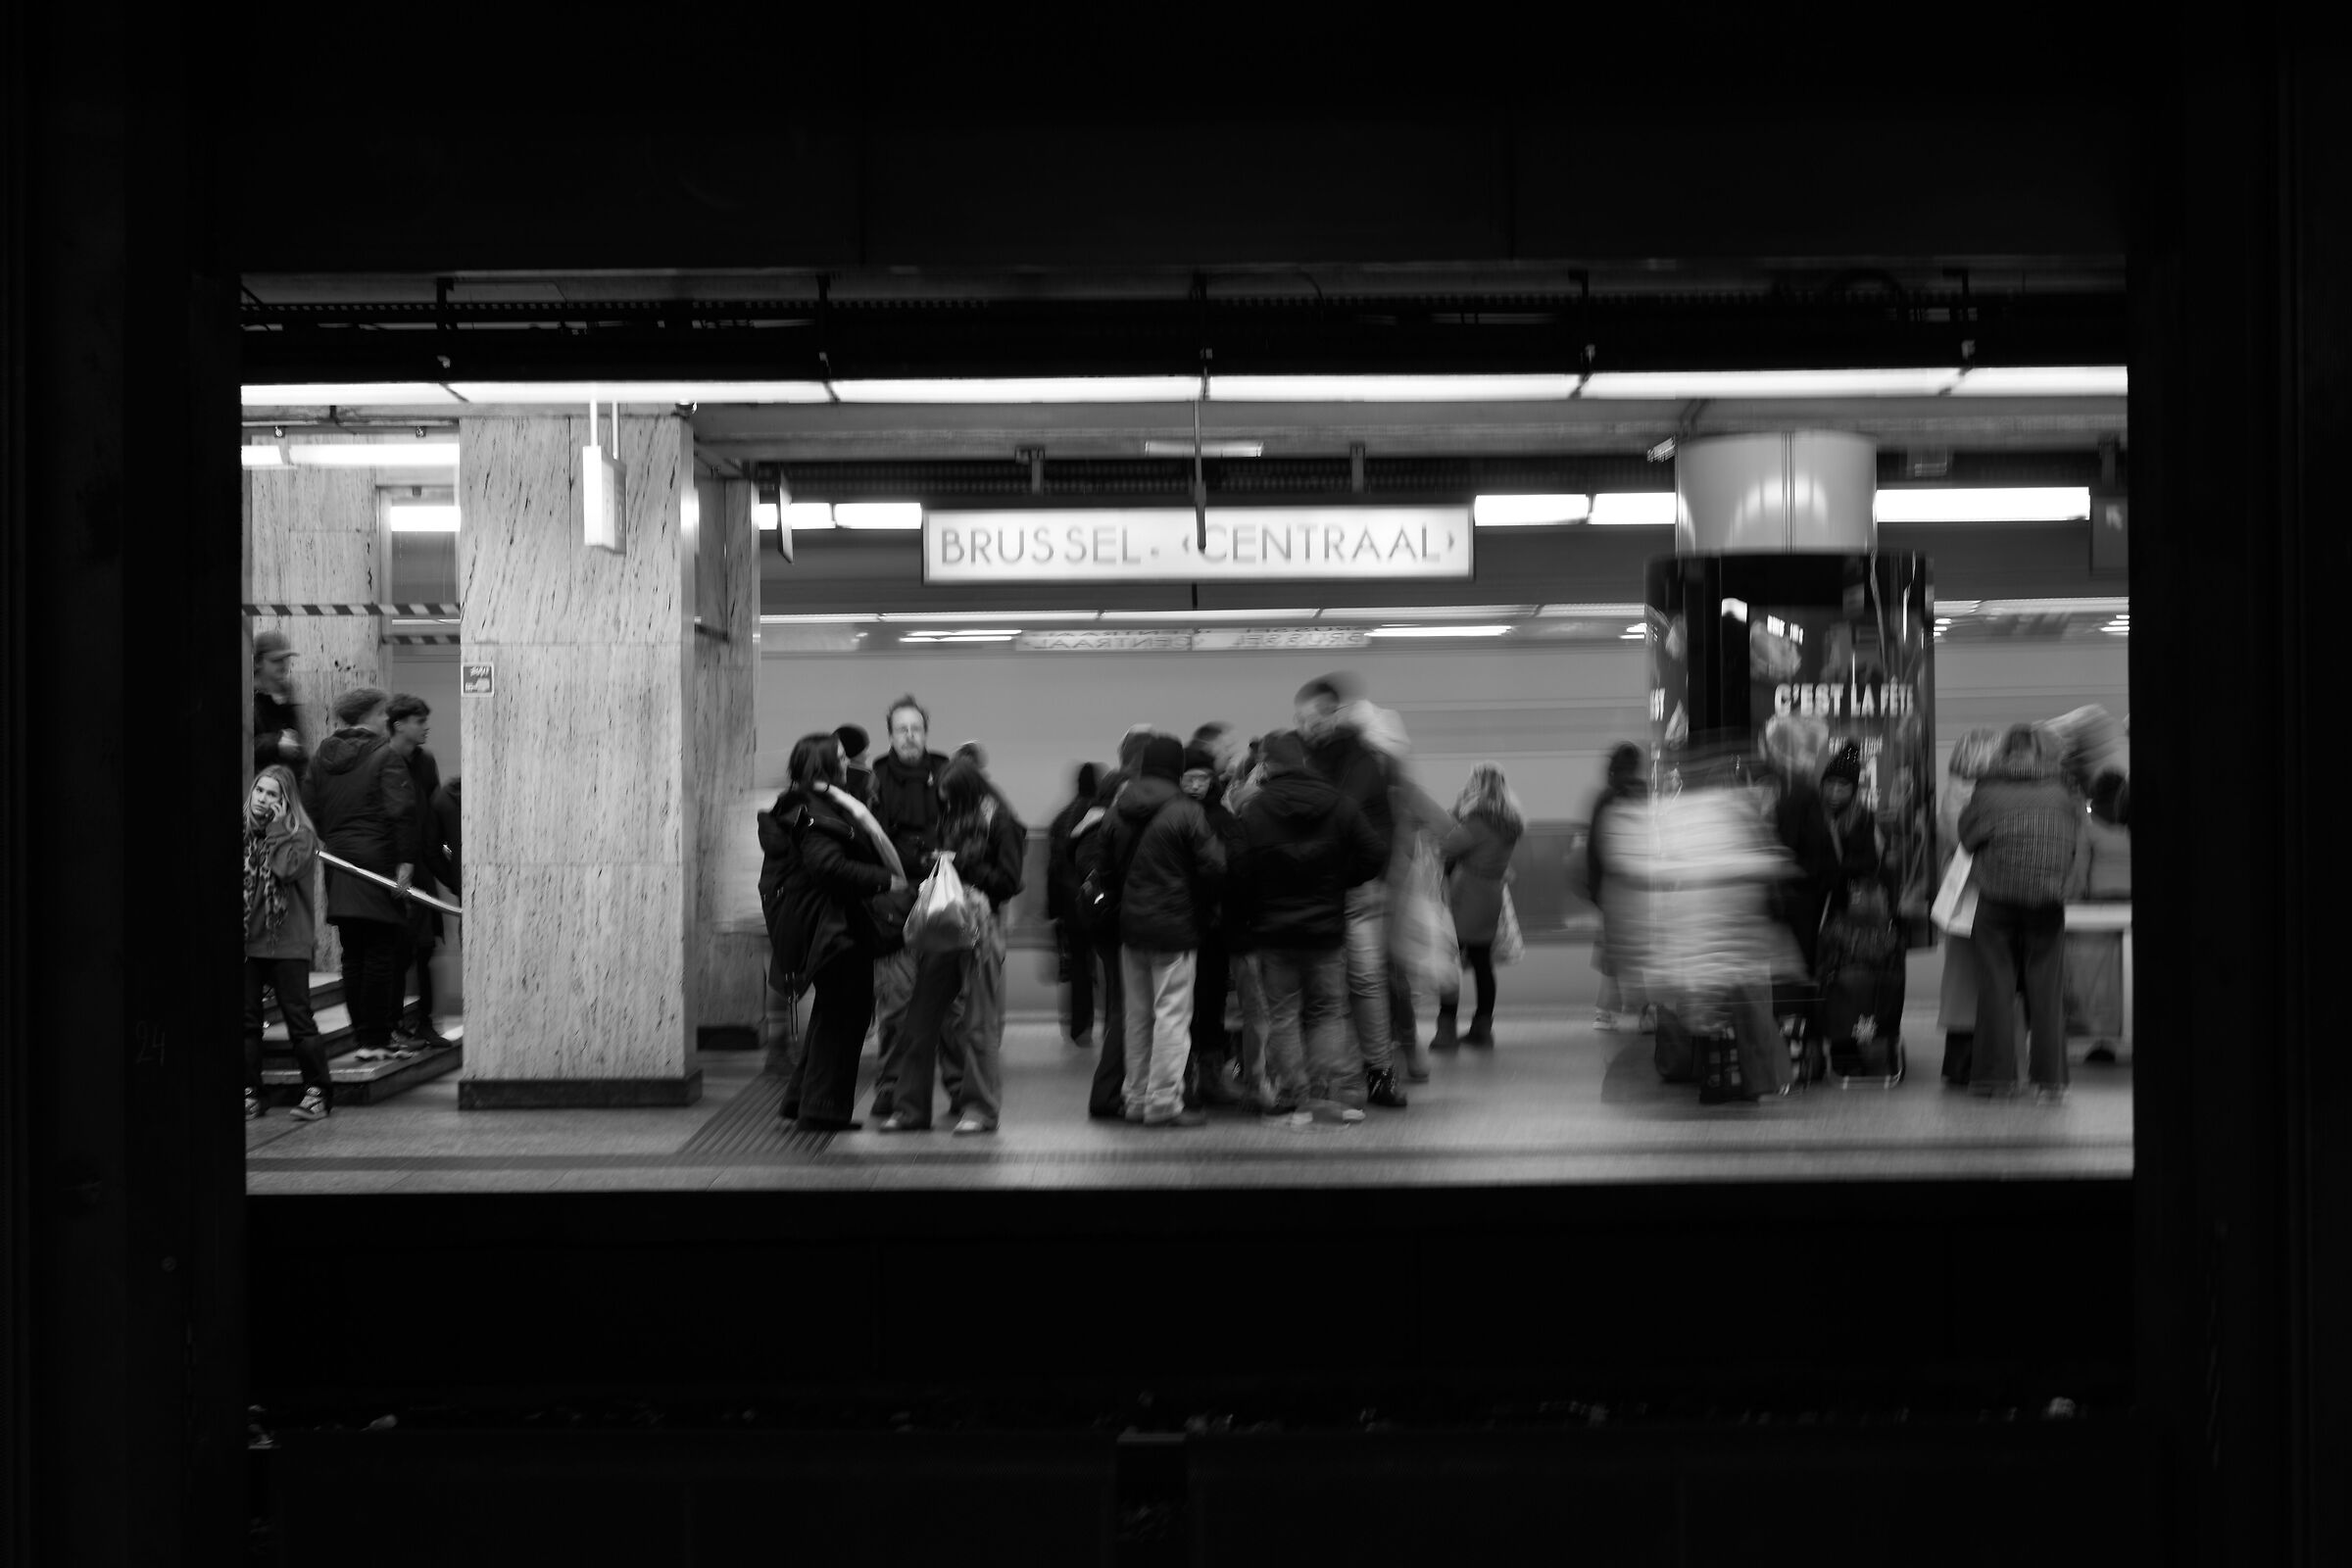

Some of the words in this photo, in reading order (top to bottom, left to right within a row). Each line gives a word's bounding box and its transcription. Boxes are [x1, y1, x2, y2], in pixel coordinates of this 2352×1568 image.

[1774, 683, 1844, 717] C'EST
[1850, 683, 1876, 717] LA
[135, 1020, 166, 1066] 24
